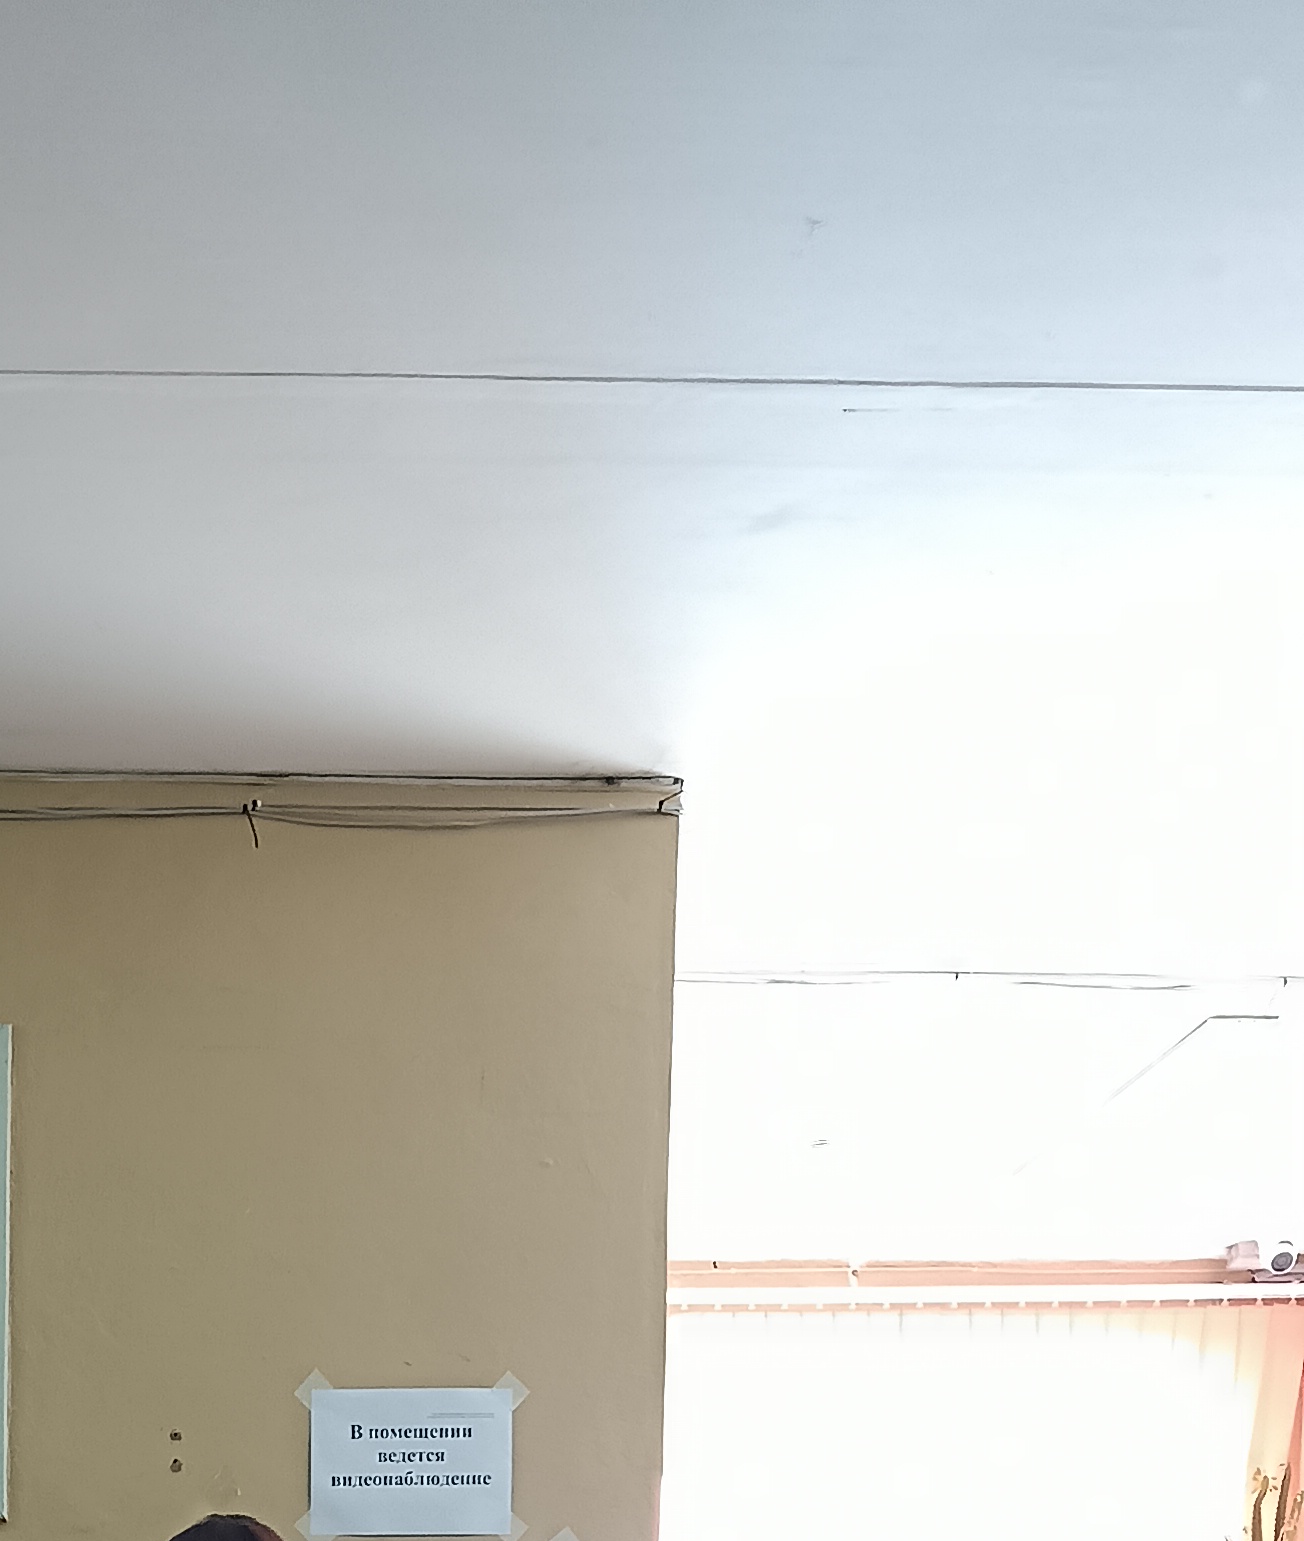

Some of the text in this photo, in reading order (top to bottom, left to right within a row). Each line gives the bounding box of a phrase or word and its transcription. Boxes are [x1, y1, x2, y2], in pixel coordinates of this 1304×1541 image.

[350, 1424, 473, 1440] В помещении
[378, 1451, 445, 1464] ведется
[331, 1471, 492, 1488] видеонаблюдение
